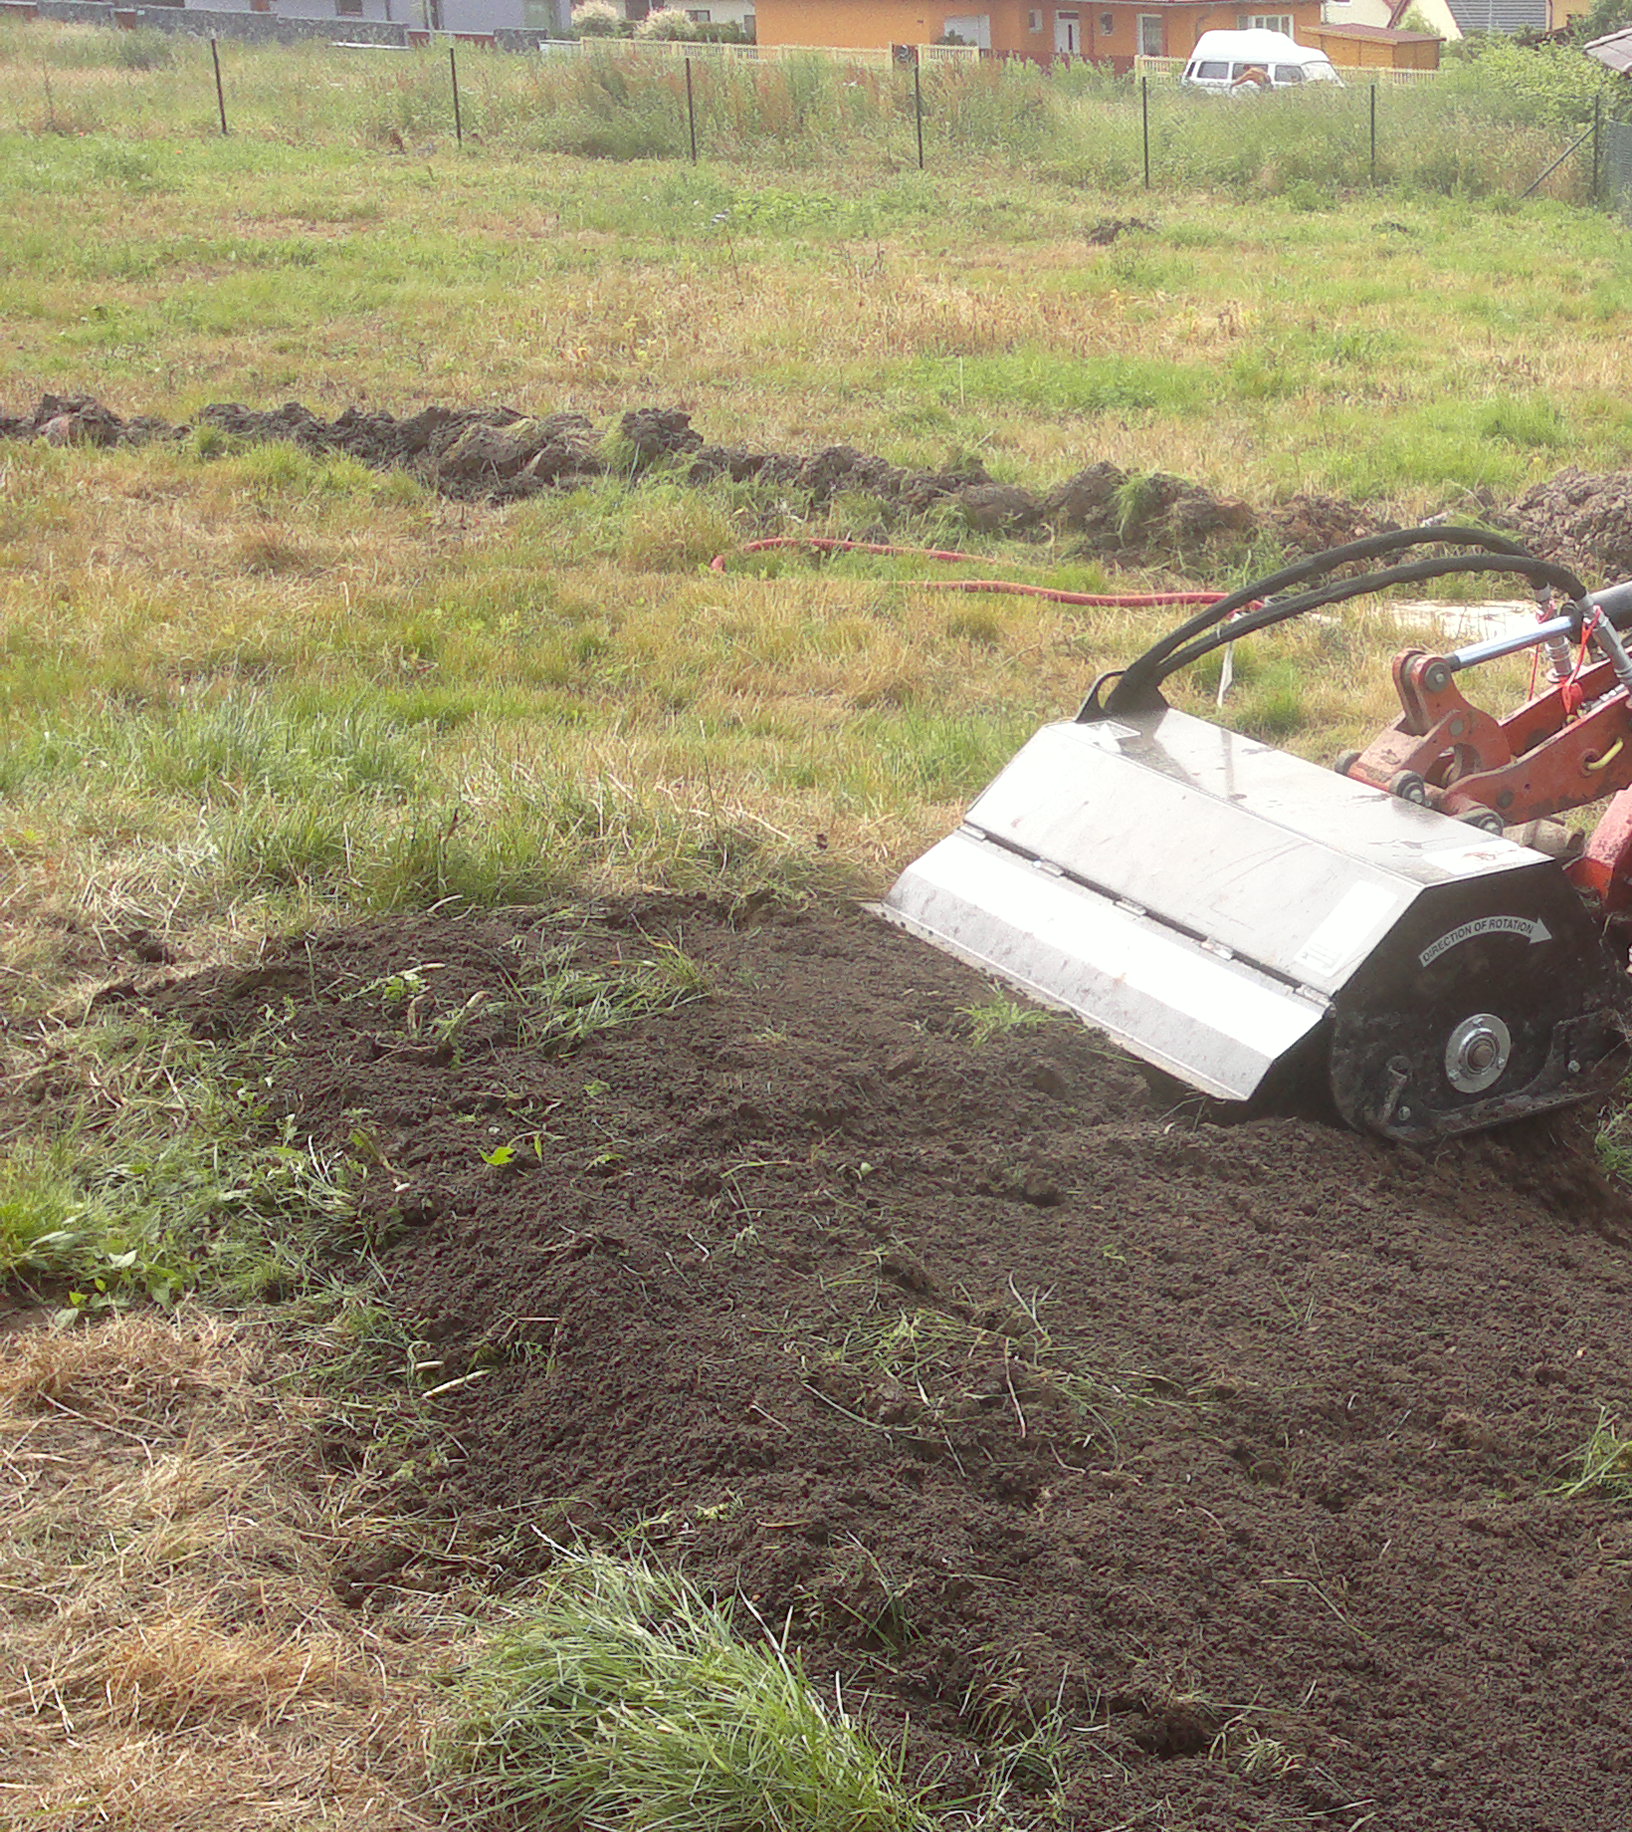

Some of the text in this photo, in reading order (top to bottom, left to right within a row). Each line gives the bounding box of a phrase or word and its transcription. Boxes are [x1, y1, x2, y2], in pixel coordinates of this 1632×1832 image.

[1422, 919, 1534, 962] DIRECTION OF ROTATION
